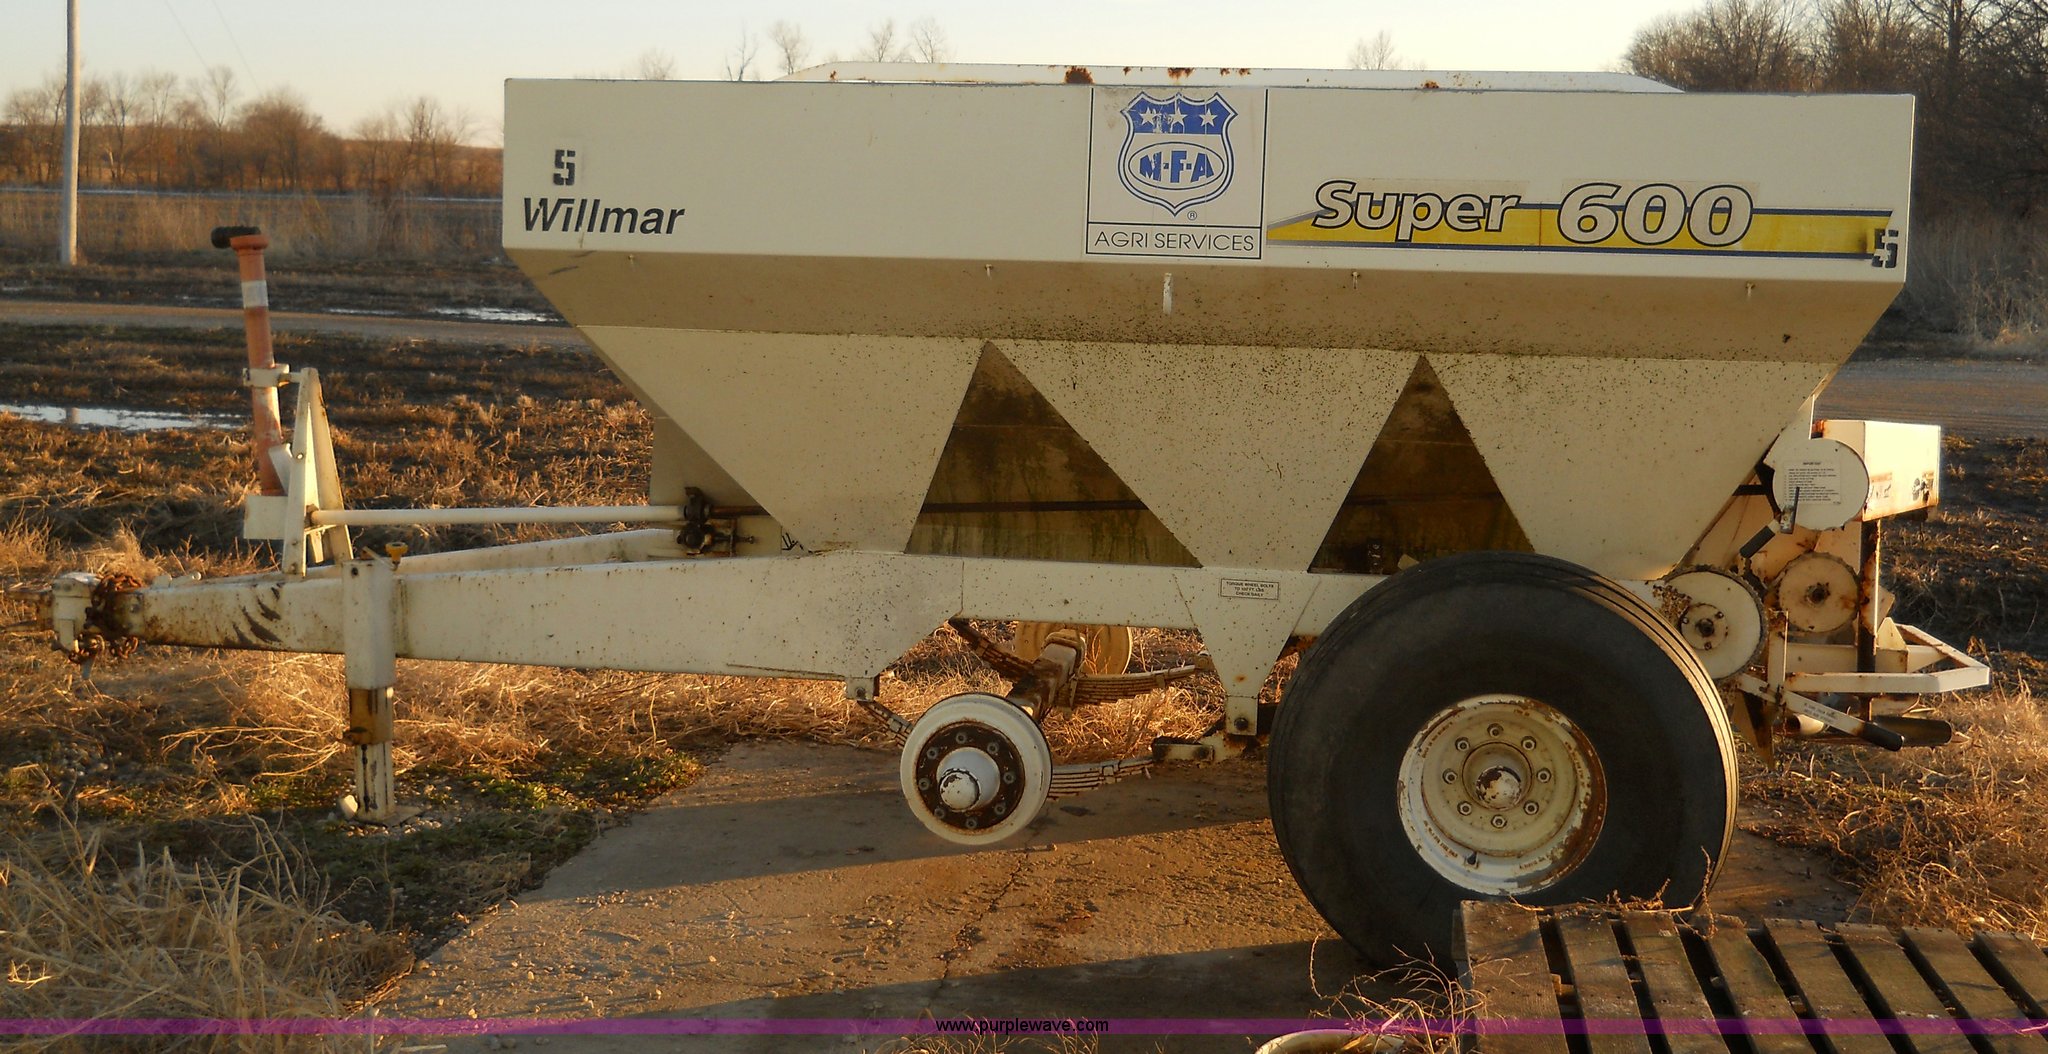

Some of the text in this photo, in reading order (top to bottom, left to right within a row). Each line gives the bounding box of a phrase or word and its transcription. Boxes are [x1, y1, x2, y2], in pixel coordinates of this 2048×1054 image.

[553, 149, 576, 186] 5
[524, 197, 686, 235] Willmar
[1311, 179, 1753, 247] Super 600
[1094, 231, 1254, 251] AGRI SERVICES
[1871, 228, 1899, 269] 5
